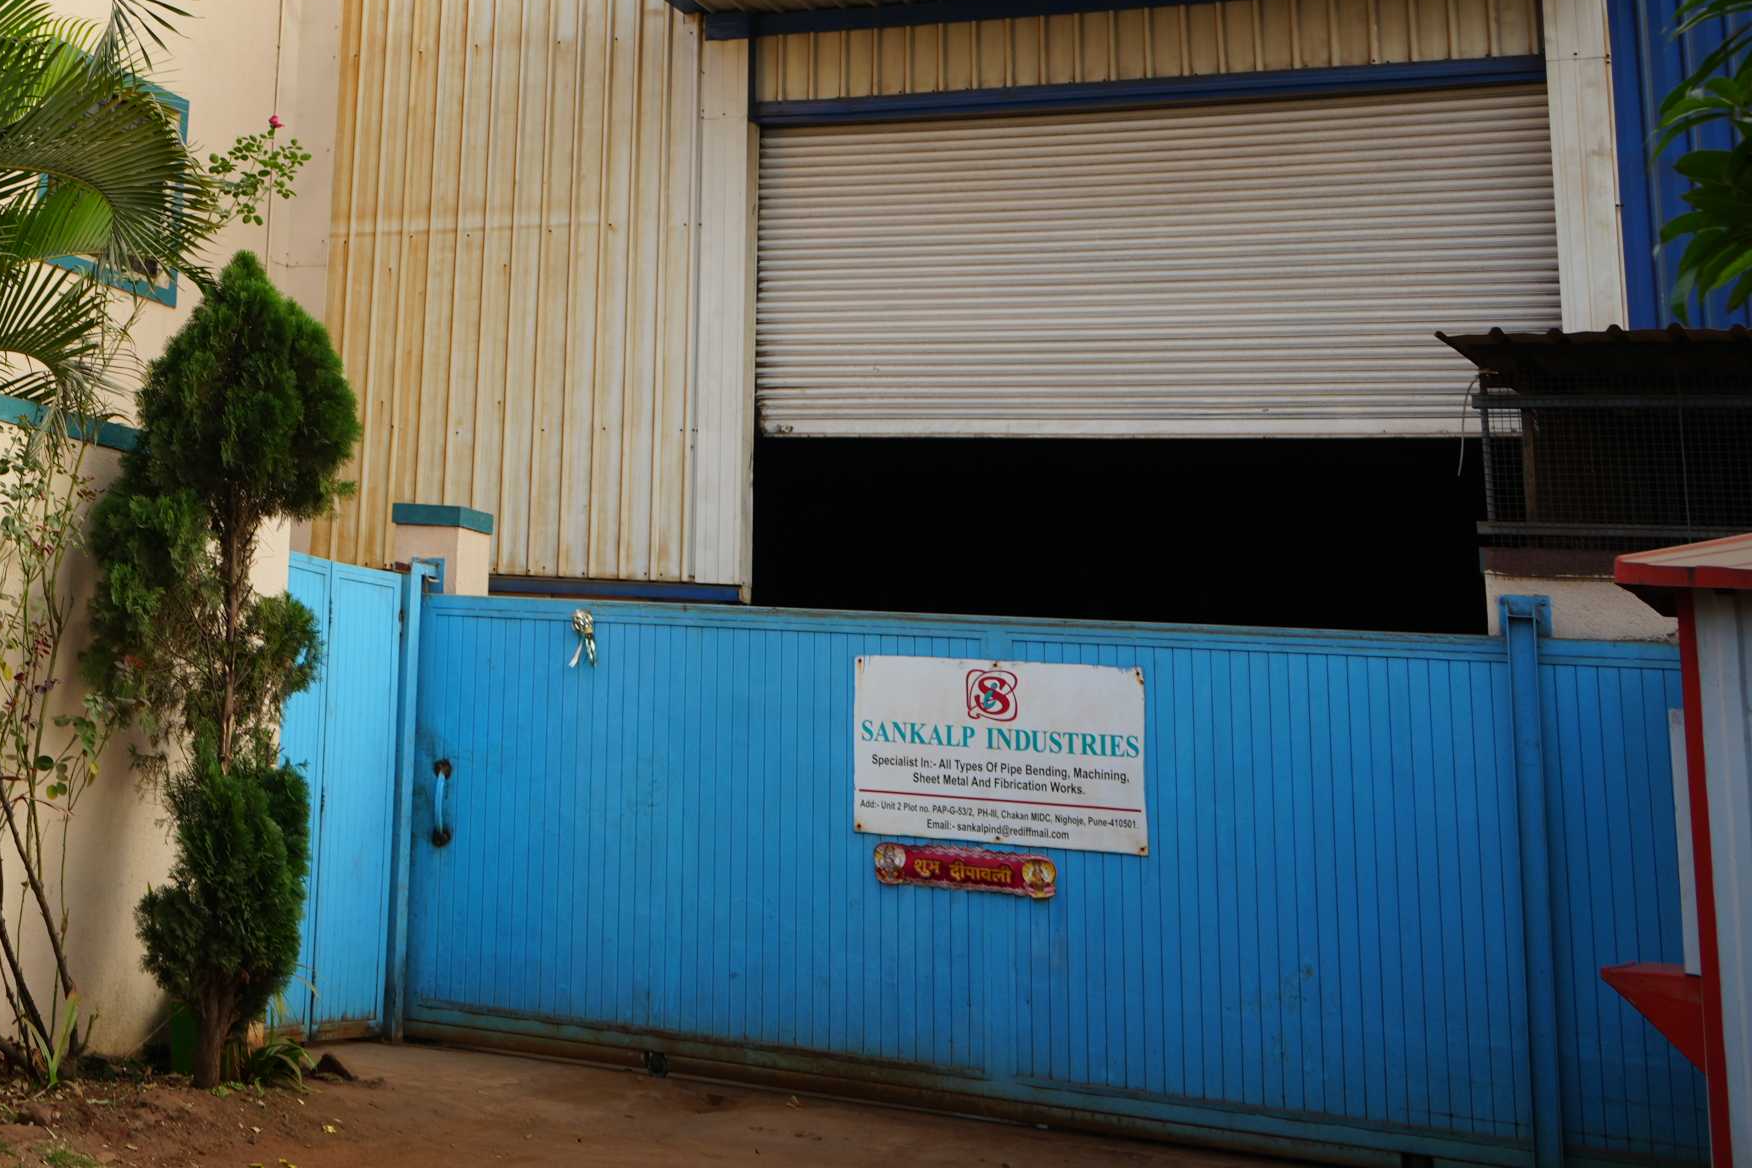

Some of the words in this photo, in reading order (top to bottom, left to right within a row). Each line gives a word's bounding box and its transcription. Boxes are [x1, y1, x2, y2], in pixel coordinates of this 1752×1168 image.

[861, 719, 976, 748] SANKALP
[986, 727, 1140, 759] INDUSTRIES
[871, 753, 918, 767] Specialist
[920, 758, 937, 769] In:-
[938, 758, 952, 770] All
[954, 759, 983, 773] Types
[985, 761, 998, 773] Of
[1000, 763, 1023, 777] Pipe
[1025, 764, 1071, 781] Bending,
[1073, 767, 1130, 784] Machining,
[912, 772, 941, 785] Sheet
[943, 774, 969, 787] Metal
[971, 777, 991, 789] And
[994, 778, 1047, 792] Fibrication
[1050, 781, 1086, 795] Works.
[881, 800, 896, 811] Unit
[896, 801, 902, 811] 2
[903, 802, 918, 812] Plot
[1001, 810, 1029, 821] Chakan
[1031, 812, 1053, 824] MIDC,
[1055, 814, 1087, 827] Nighoje,
[956, 822, 1069, 840] sankalpind@rediffmail.com
[948, 861, 1012, 883] दीपावली
